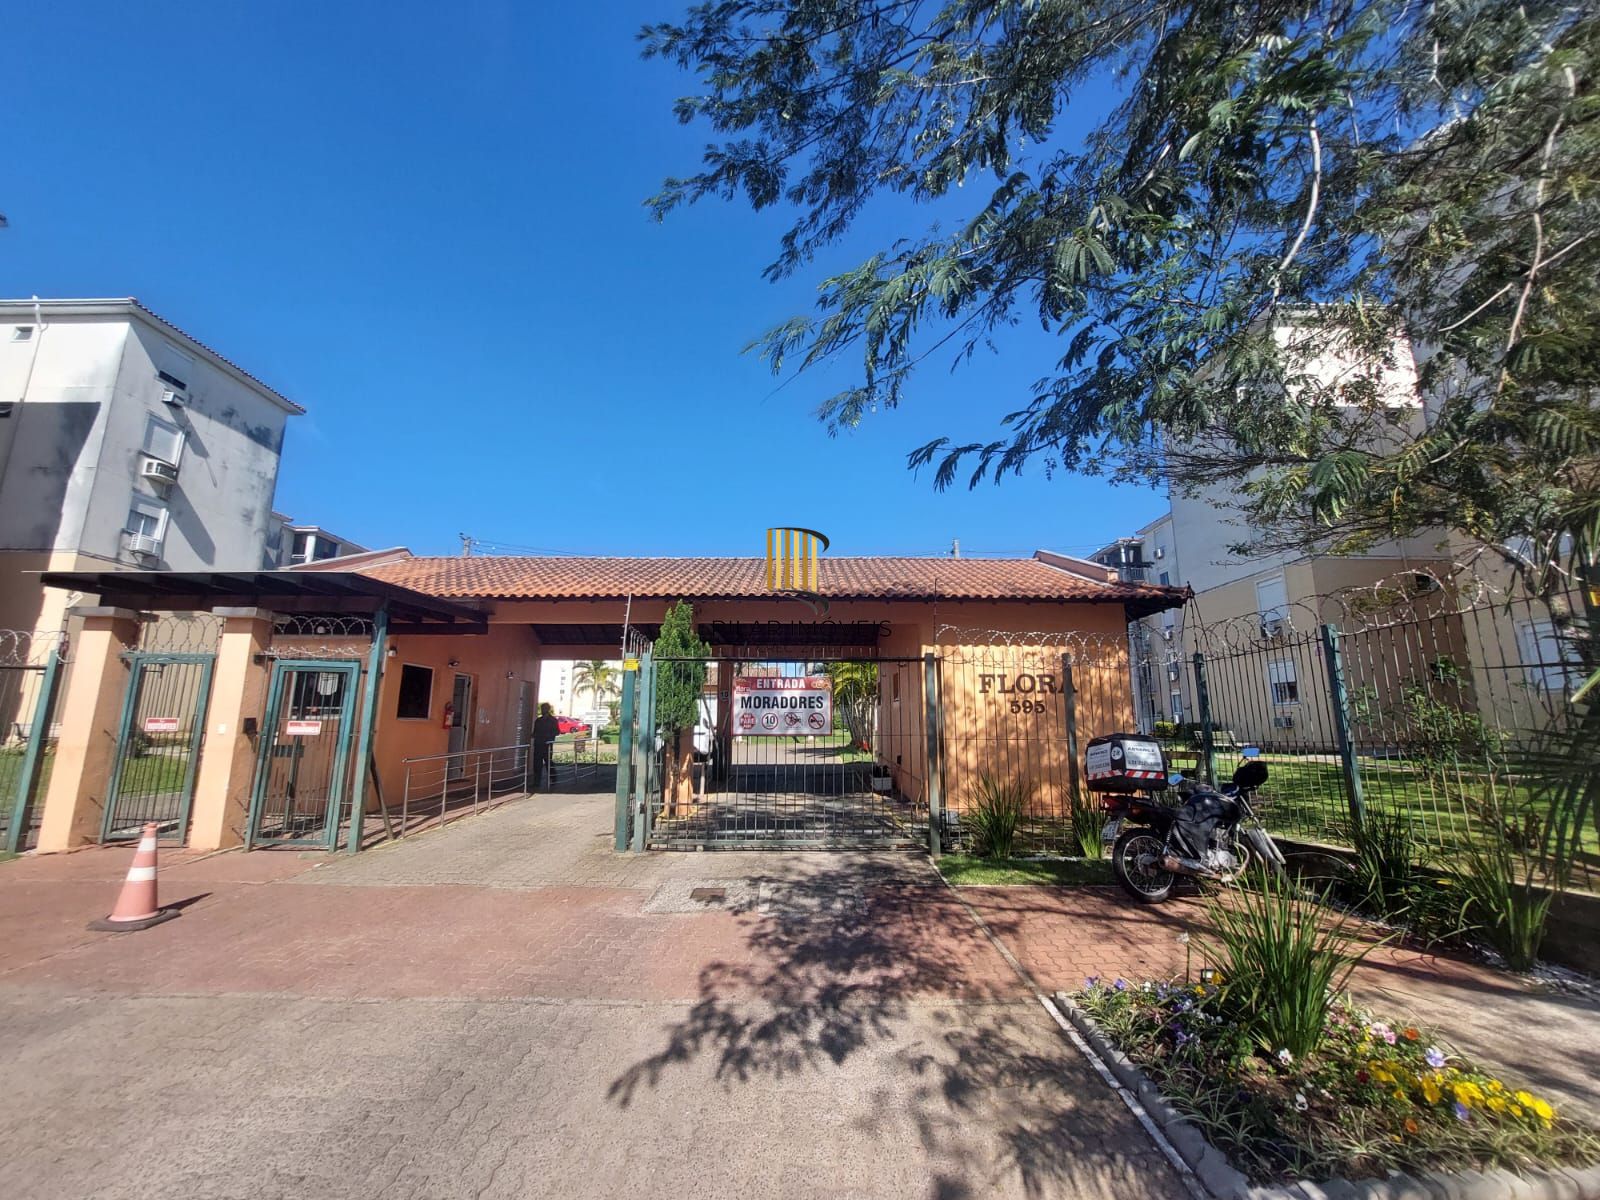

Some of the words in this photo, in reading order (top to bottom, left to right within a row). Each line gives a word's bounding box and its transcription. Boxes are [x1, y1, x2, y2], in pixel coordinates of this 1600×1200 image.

[757, 679, 805, 689] ENTRADA
[741, 696, 824, 709] MORADORES
[1010, 699, 1045, 714] 595
[765, 716, 776, 724] 10
